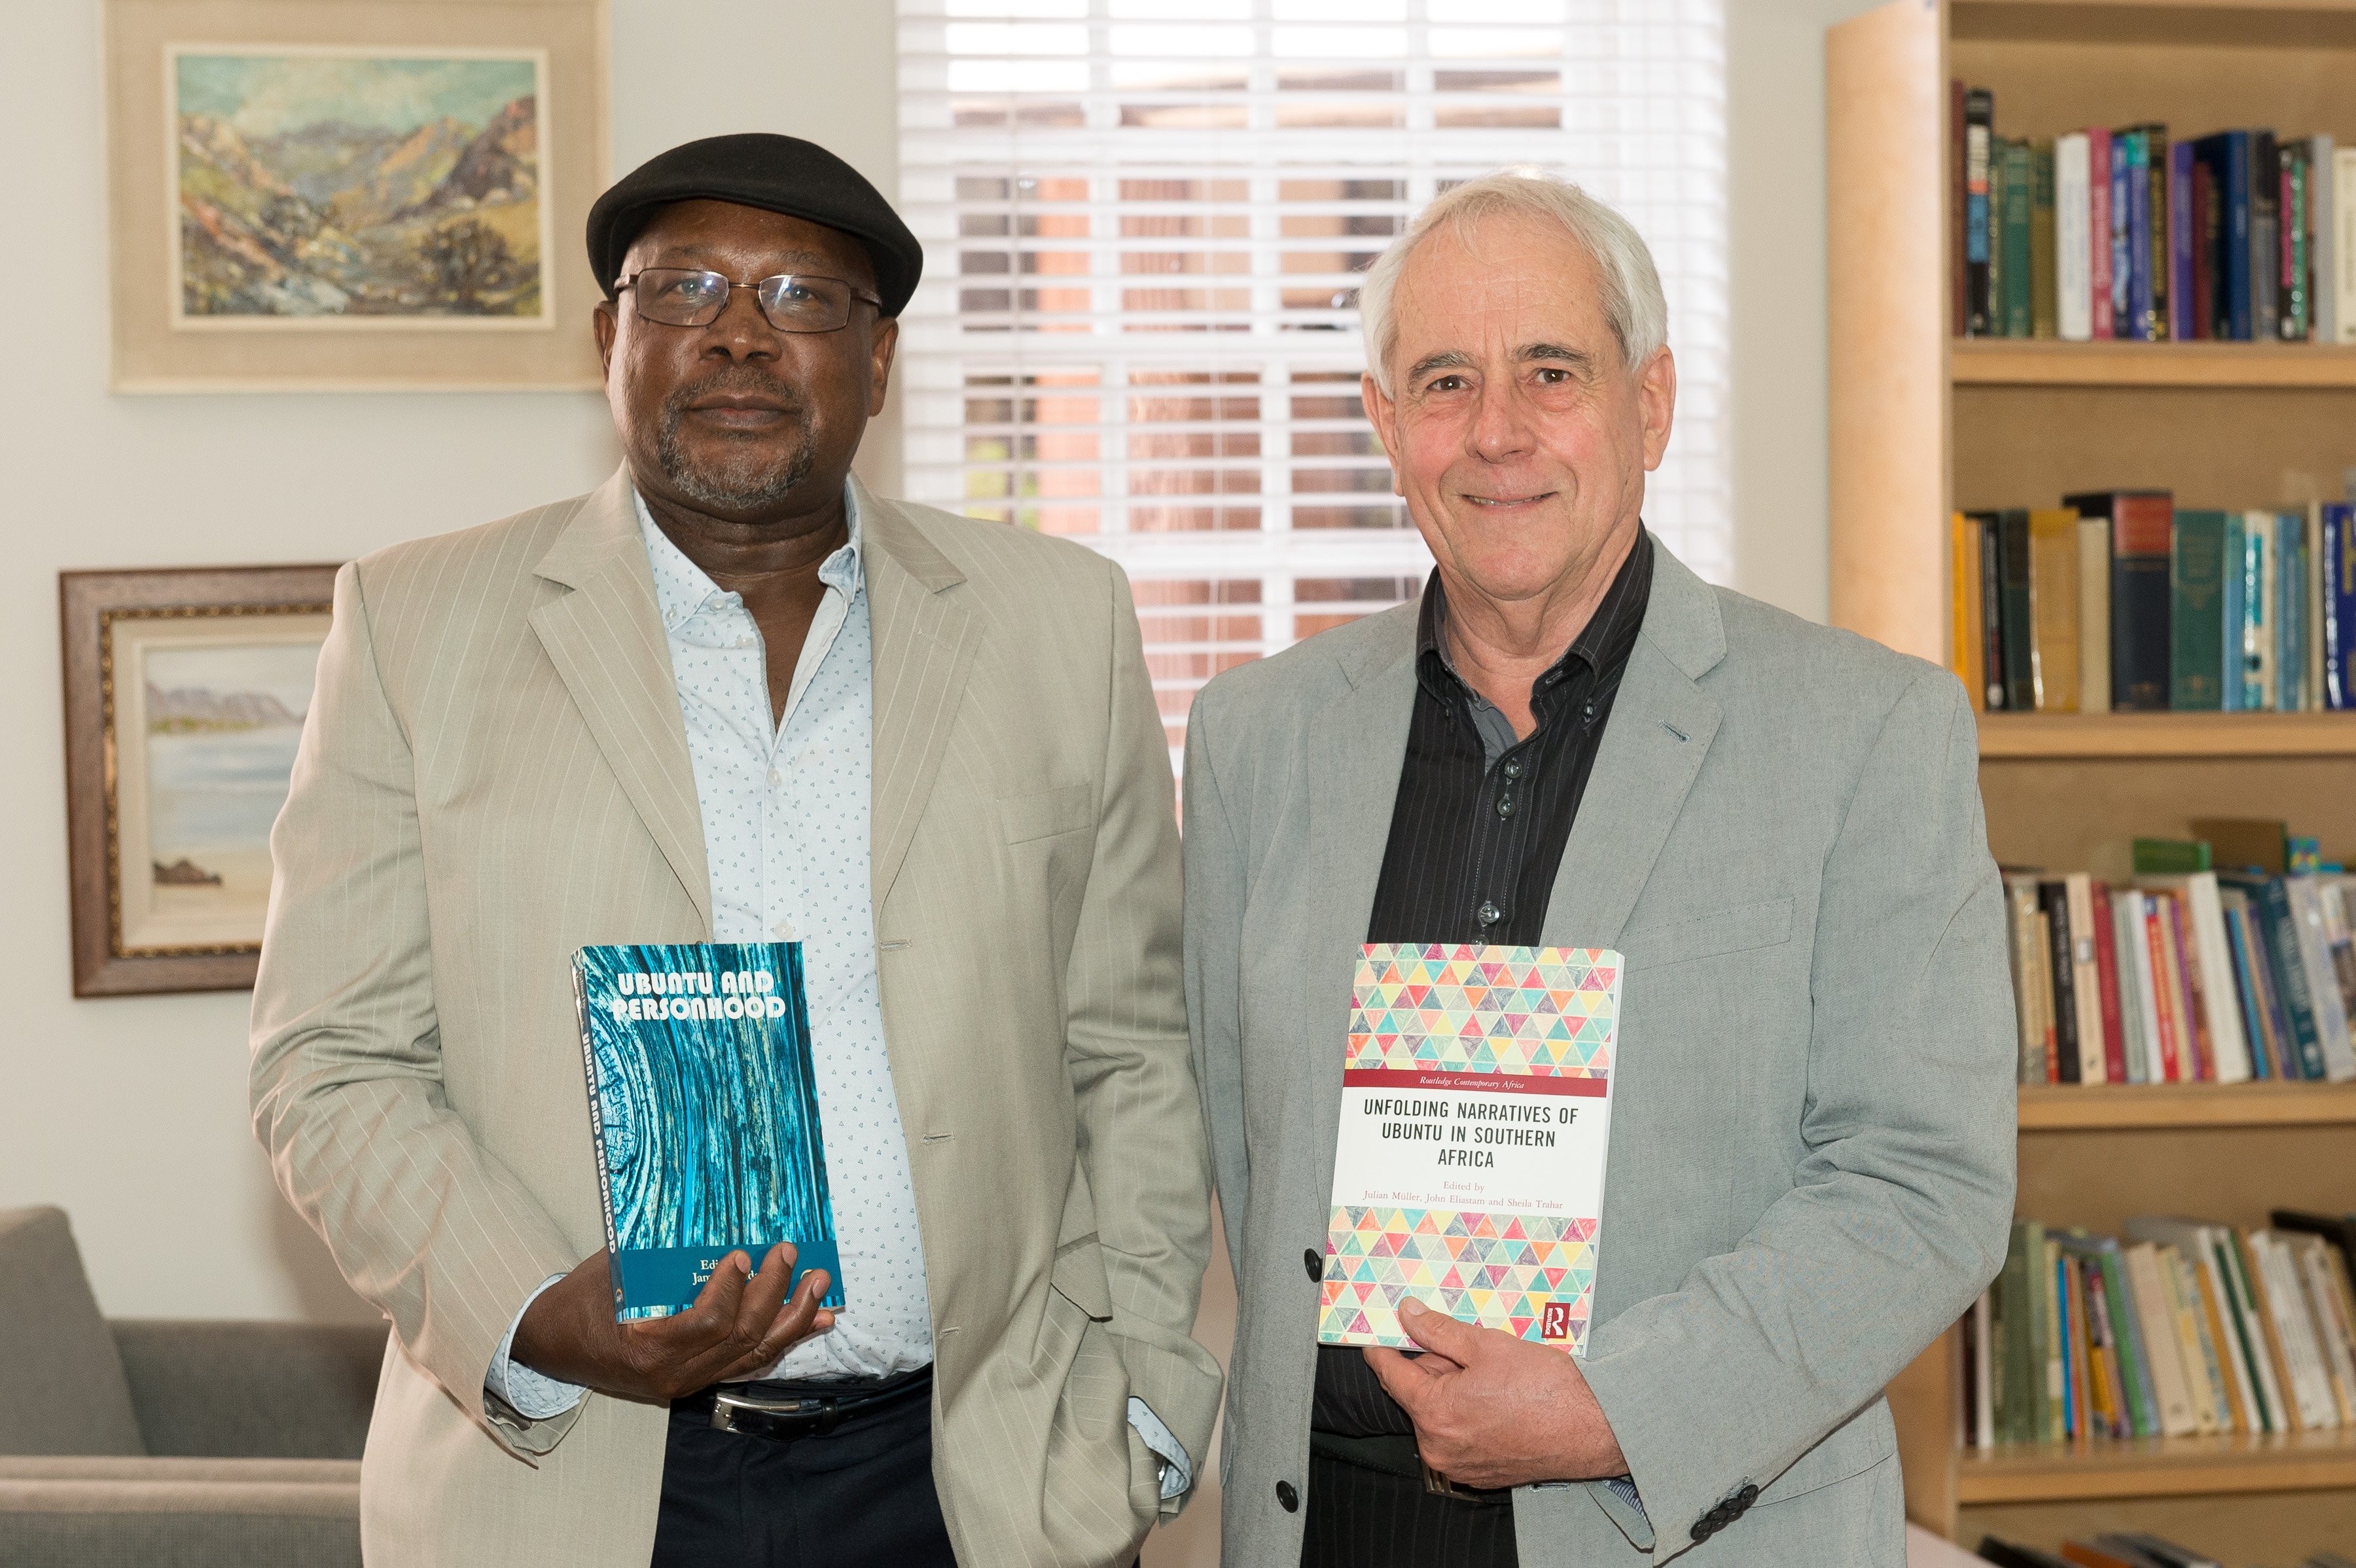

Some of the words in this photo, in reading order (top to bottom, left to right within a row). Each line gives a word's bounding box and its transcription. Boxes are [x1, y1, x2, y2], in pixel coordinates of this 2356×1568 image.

[617, 972, 713, 995] UBUNTU
[721, 971, 774, 994] AND
[613, 996, 786, 1021] PERSONHOOD
[1419, 1076, 1452, 1087] Routledge
[1454, 1078, 1500, 1089] Contemporary
[1502, 1080, 1525, 1090] Africa
[1364, 1099, 1448, 1118] UNFOLDING
[1457, 1102, 1550, 1123] NARRATIVES
[1559, 1107, 1579, 1124] OF
[582, 1032, 596, 1096] UBUNTU
[590, 1099, 601, 1135] AND
[596, 1139, 616, 1254] PERSONHOOD
[1382, 1122, 1442, 1141] UBUNTU
[1451, 1126, 1467, 1143] IN
[1474, 1127, 1556, 1147] SOUTHERN
[1438, 1149, 1493, 1167] AFRICA
[1443, 1181, 1471, 1191] Edited
[1474, 1183, 1485, 1193] by
[1362, 1190, 1388, 1200] Julian
[1391, 1192, 1422, 1202] Müller,
[1425, 1193, 1446, 1203] John
[1450, 1195, 1485, 1205] Eliastam
[1488, 1198, 1504, 1206] and
[1507, 1198, 1532, 1207] Sheila
[1535, 1200, 1563, 1209] Trahar
